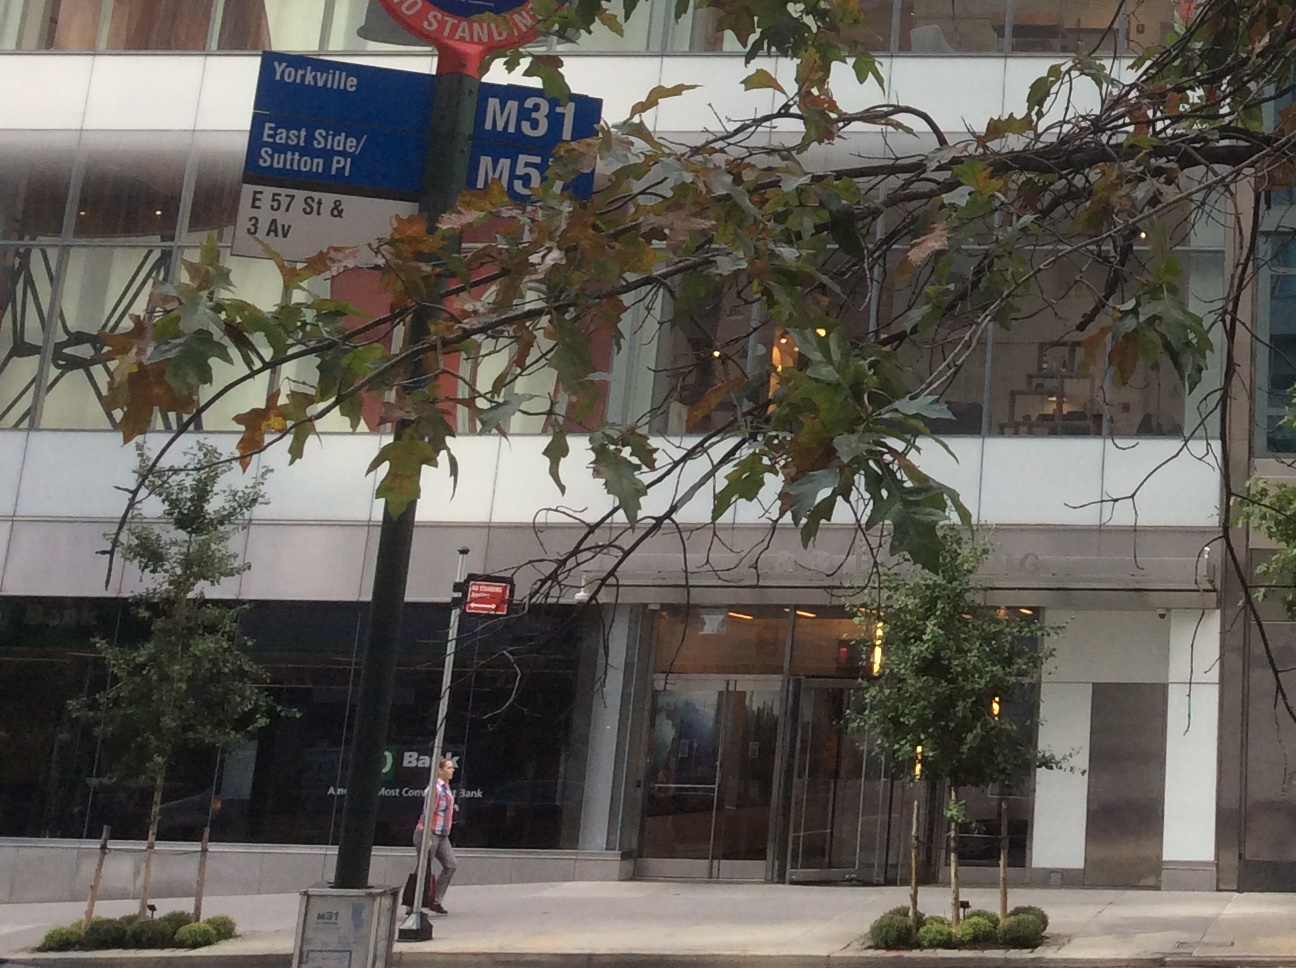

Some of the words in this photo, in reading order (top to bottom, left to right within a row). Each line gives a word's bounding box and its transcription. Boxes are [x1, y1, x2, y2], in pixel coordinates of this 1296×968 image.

[273, 61, 358, 92] Yorkville
[484, 96, 576, 141] M31
[262, 122, 307, 147] East
[313, 128, 368, 156] Side/
[258, 147, 324, 174] Sutton
[330, 155, 352, 177] Pl
[476, 153, 566, 196] M5
[250, 190, 264, 210] E
[270, 192, 296, 213] 57
[302, 195, 324, 216] St
[329, 199, 345, 219] &
[246, 216, 259, 236] 3
[265, 218, 292, 239] Av
[402, 751, 461, 769] Bak
